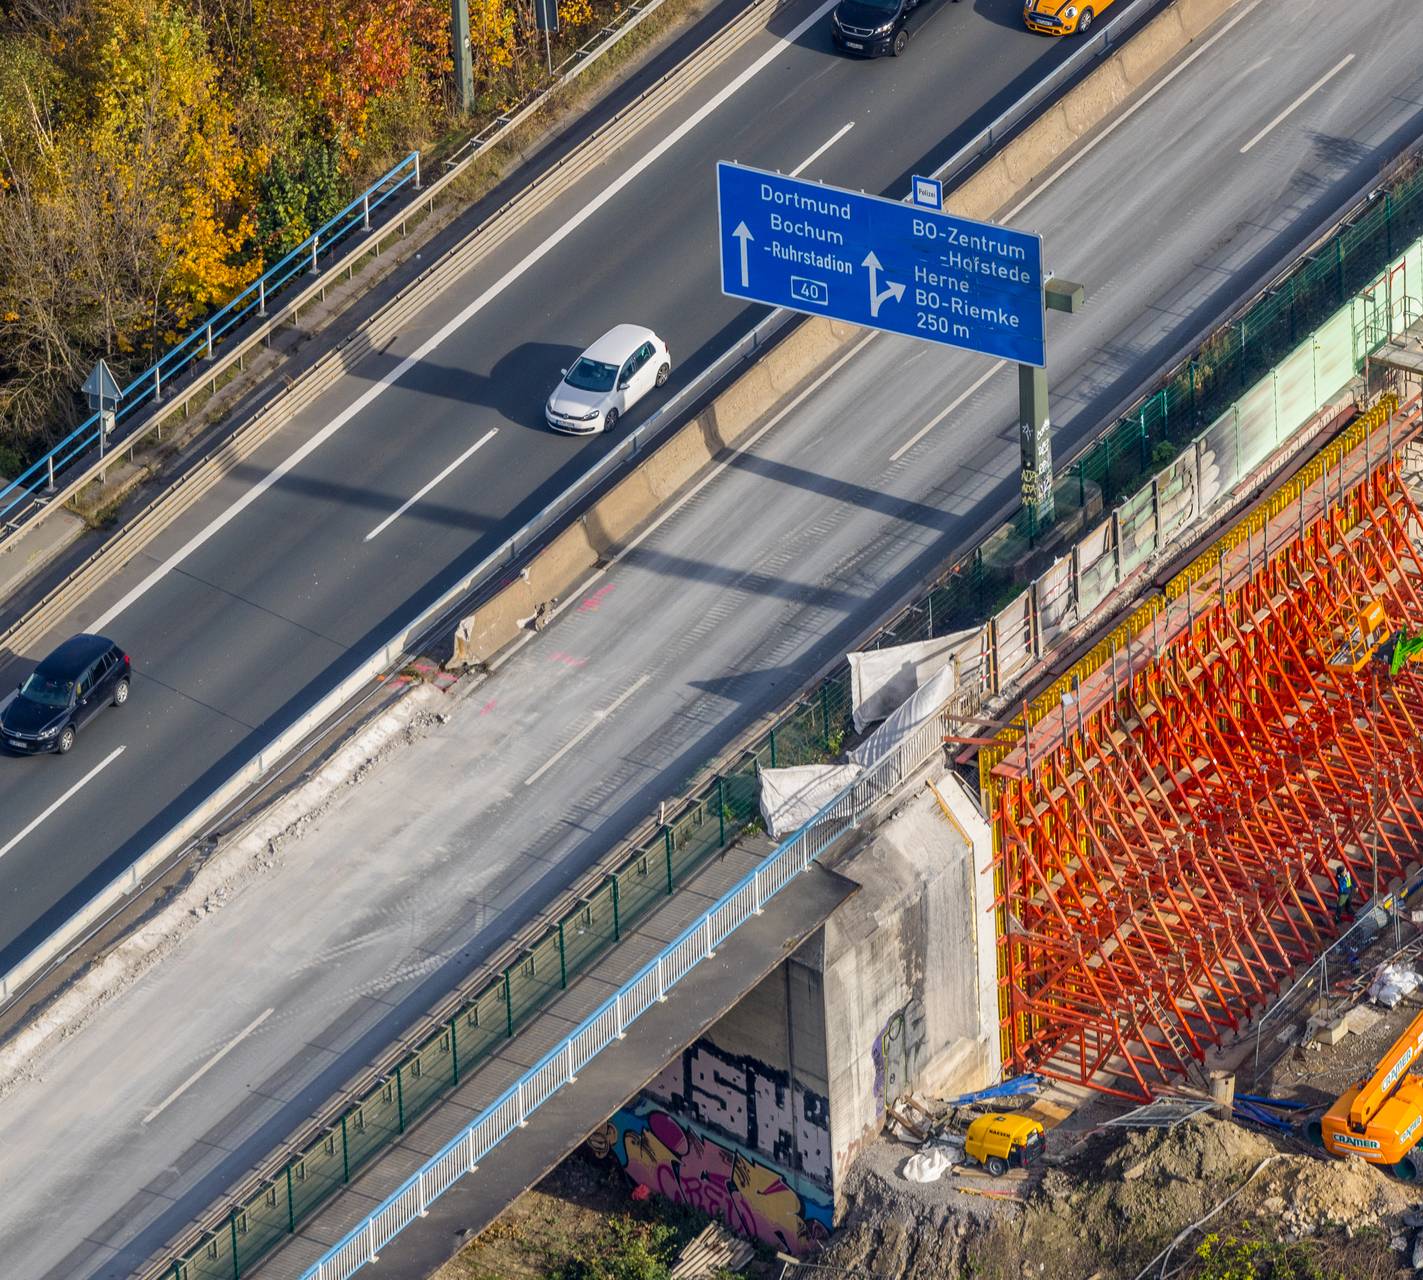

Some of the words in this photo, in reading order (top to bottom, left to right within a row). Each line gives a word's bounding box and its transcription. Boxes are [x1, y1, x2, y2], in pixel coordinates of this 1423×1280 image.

[761, 184, 851, 220] Dortmund
[770, 213, 843, 245] Bochum
[913, 219, 1025, 260] BO-Zentrum
[764, 242, 853, 275] -Ruhrstadion
[940, 251, 1030, 284] -Hofstede
[801, 283, 819, 299] 40
[915, 266, 969, 293] Herne
[916, 288, 1019, 328] BO-Riemke
[917, 313, 948, 334] 250
[953, 325, 969, 339] m
[1382, 1049, 1412, 1090] CRAMER
[1333, 1134, 1378, 1148] CRAMER
